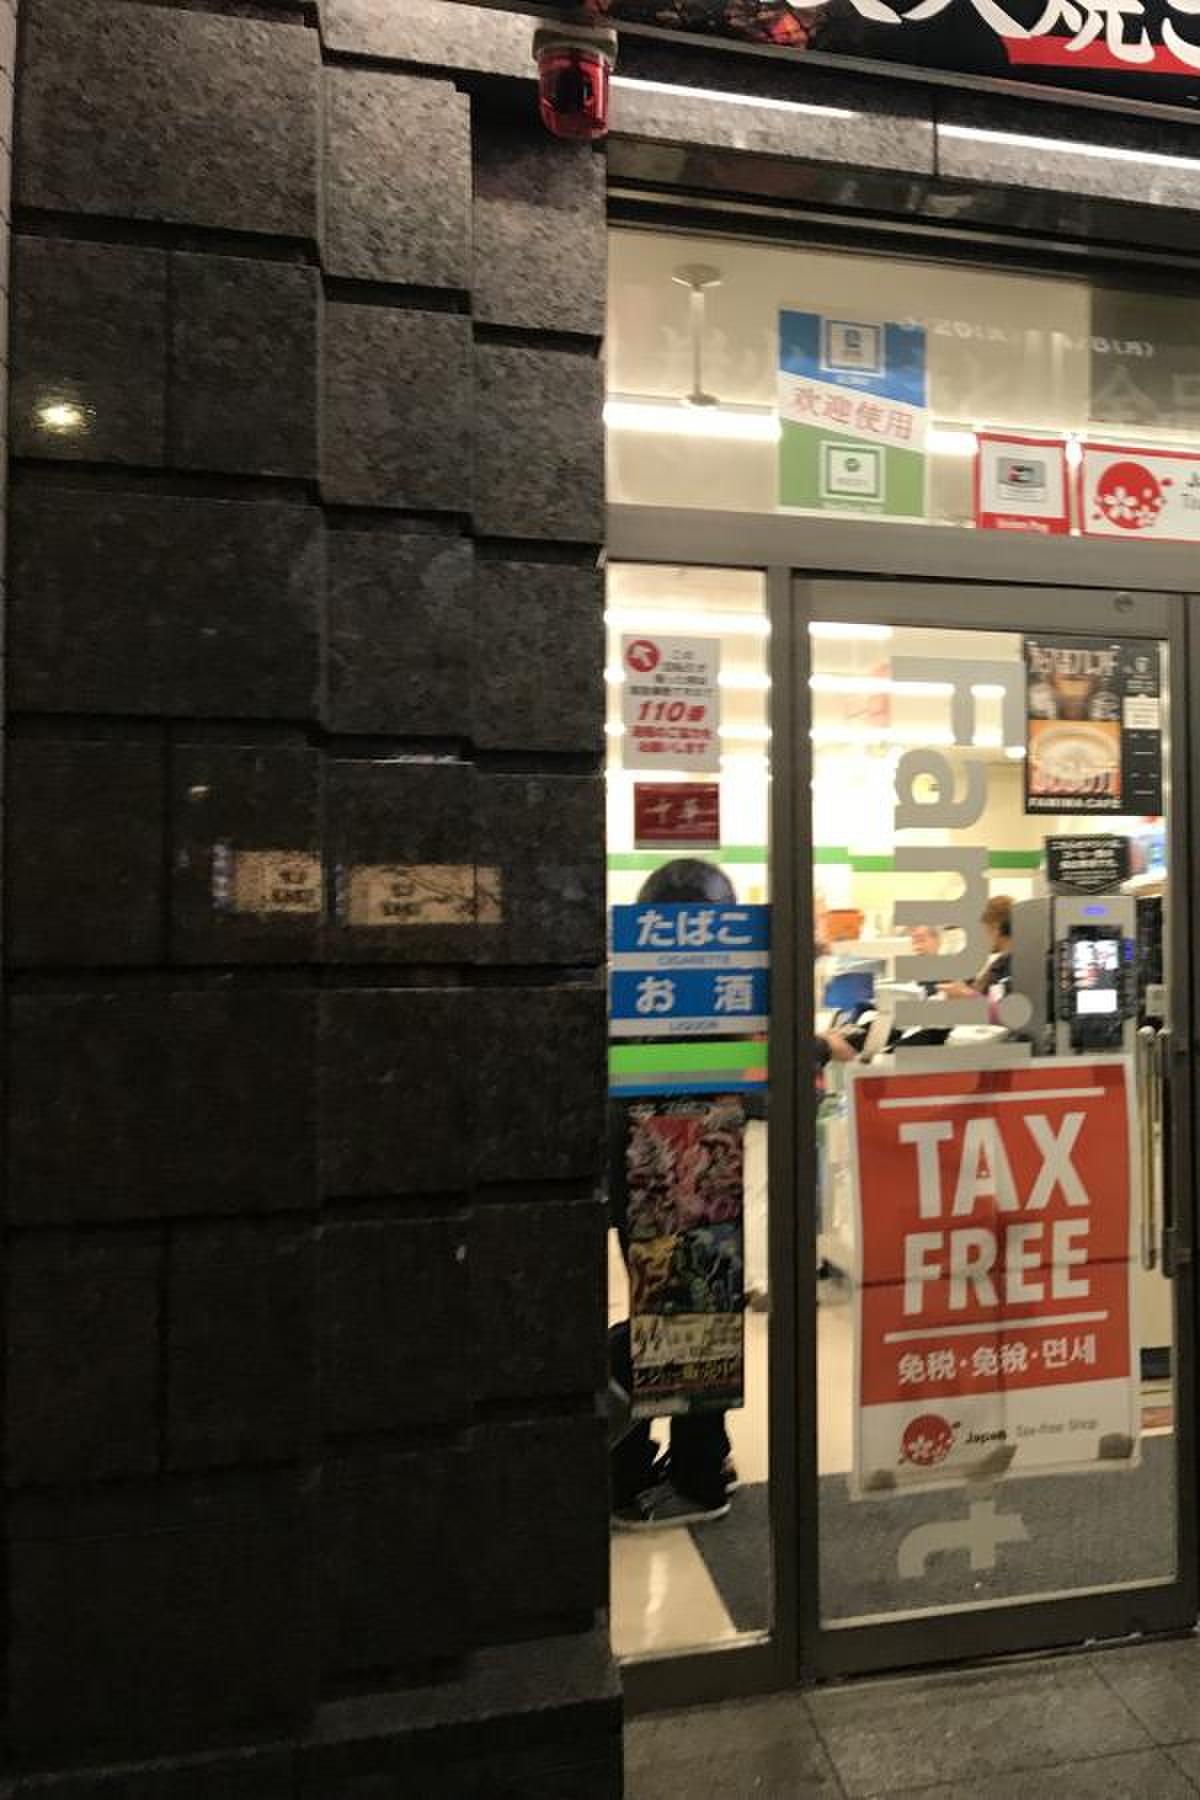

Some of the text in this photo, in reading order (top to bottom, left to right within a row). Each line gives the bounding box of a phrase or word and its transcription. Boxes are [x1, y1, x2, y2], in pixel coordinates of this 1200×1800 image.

[637, 908, 753, 947] たばこ
[898, 1111, 1090, 1219] TAX
[902, 1217, 1090, 1317] FREE
